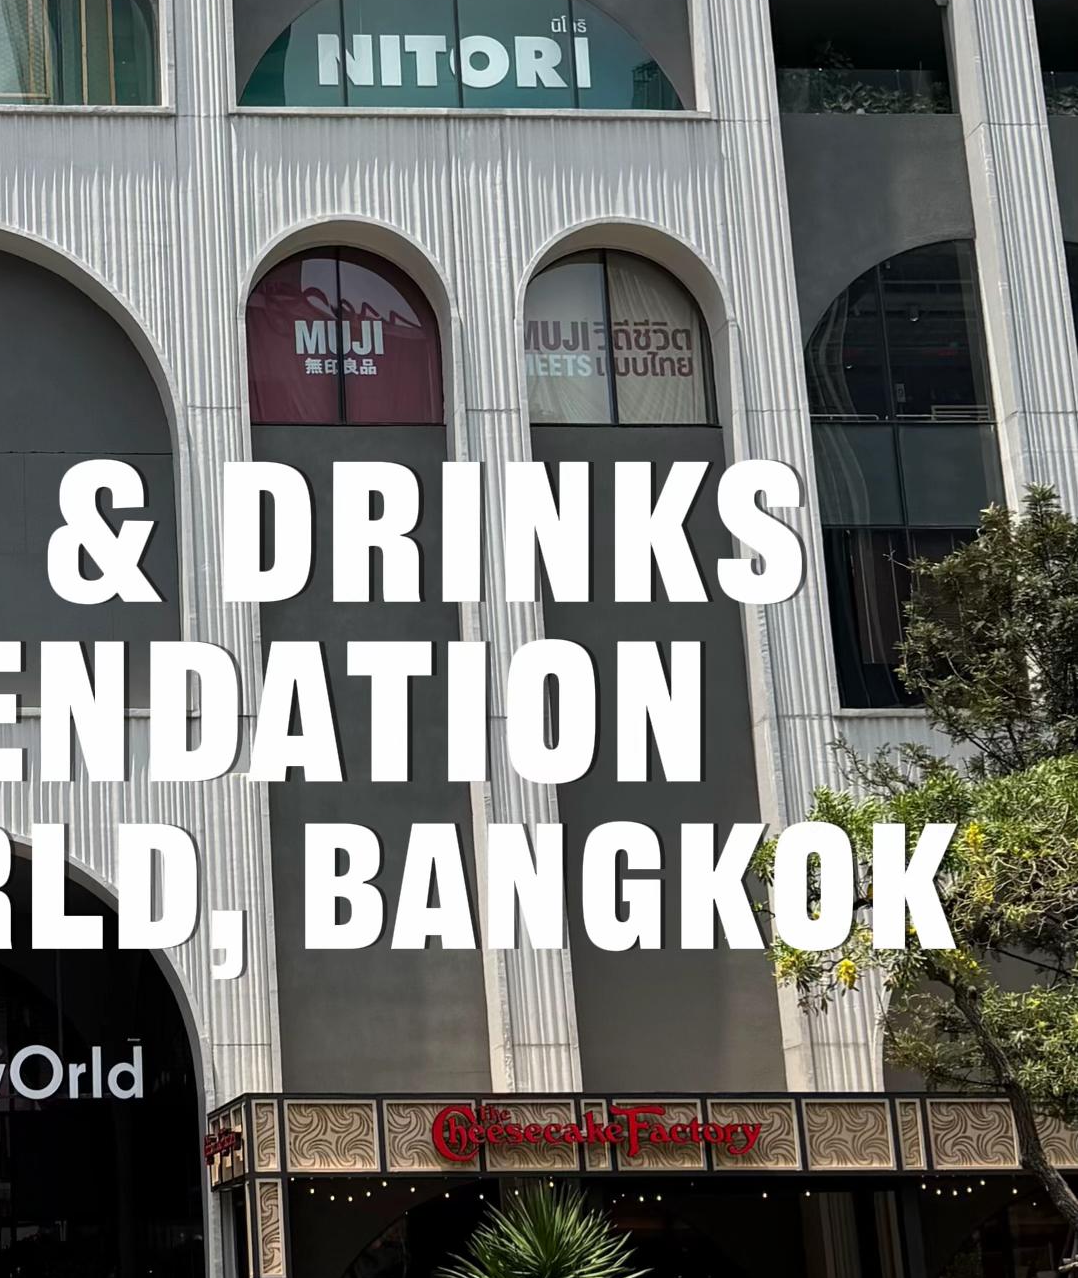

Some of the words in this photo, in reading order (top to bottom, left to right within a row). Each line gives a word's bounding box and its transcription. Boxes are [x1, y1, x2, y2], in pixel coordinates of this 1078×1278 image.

[317, 33, 592, 88] NITORI
[294, 320, 385, 355] MUJI
[305, 357, 377, 375] 無印良品
[431, 1104, 624, 1162] Cheesecake
[609, 1104, 762, 1158] Factory
